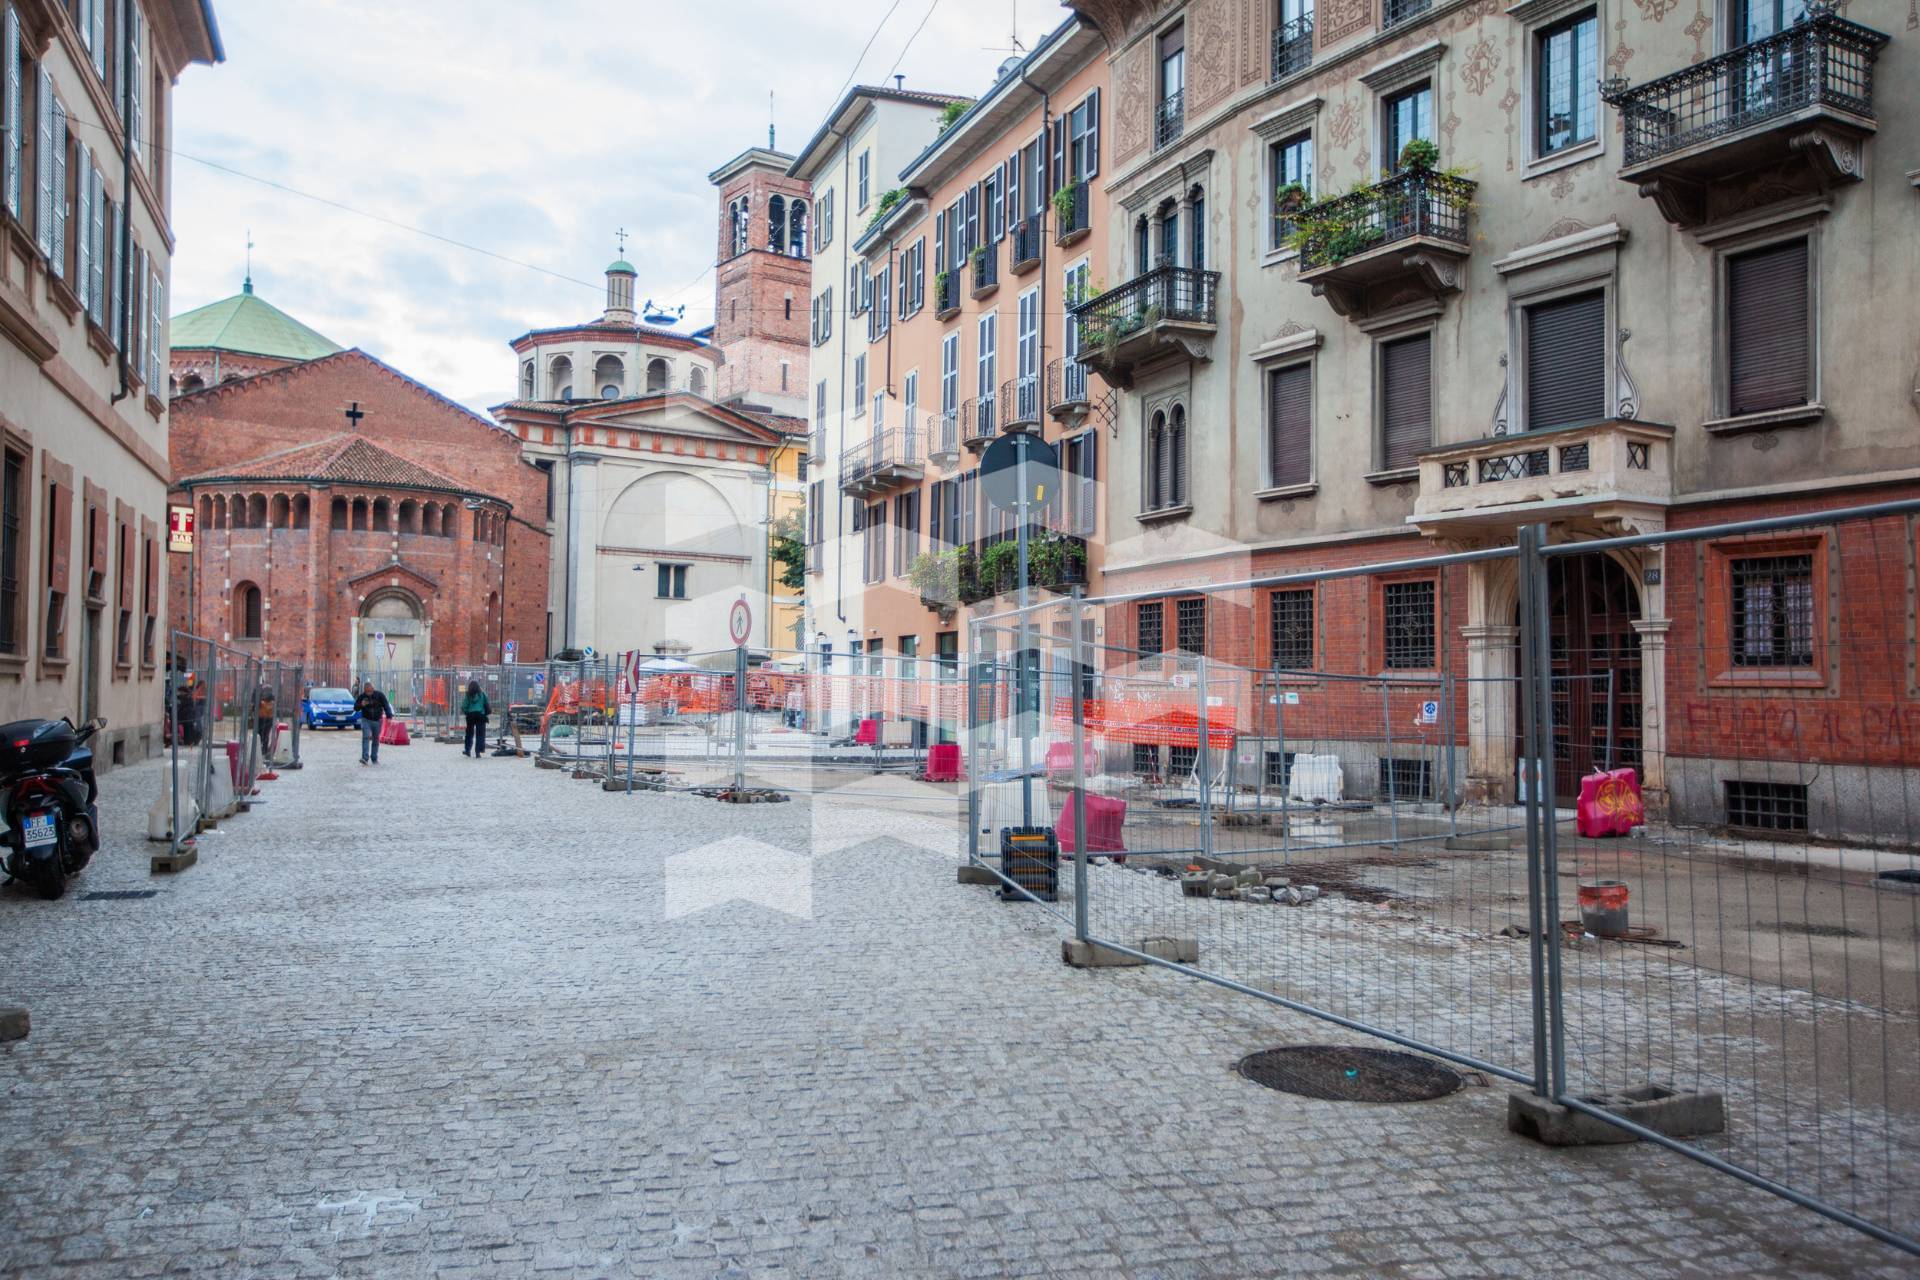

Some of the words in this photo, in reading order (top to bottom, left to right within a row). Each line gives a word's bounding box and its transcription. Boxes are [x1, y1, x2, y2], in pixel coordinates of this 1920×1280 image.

[173, 534, 192, 543] BAR
[1821, 711, 1855, 744] AL
[26, 827, 55, 840] 35623
